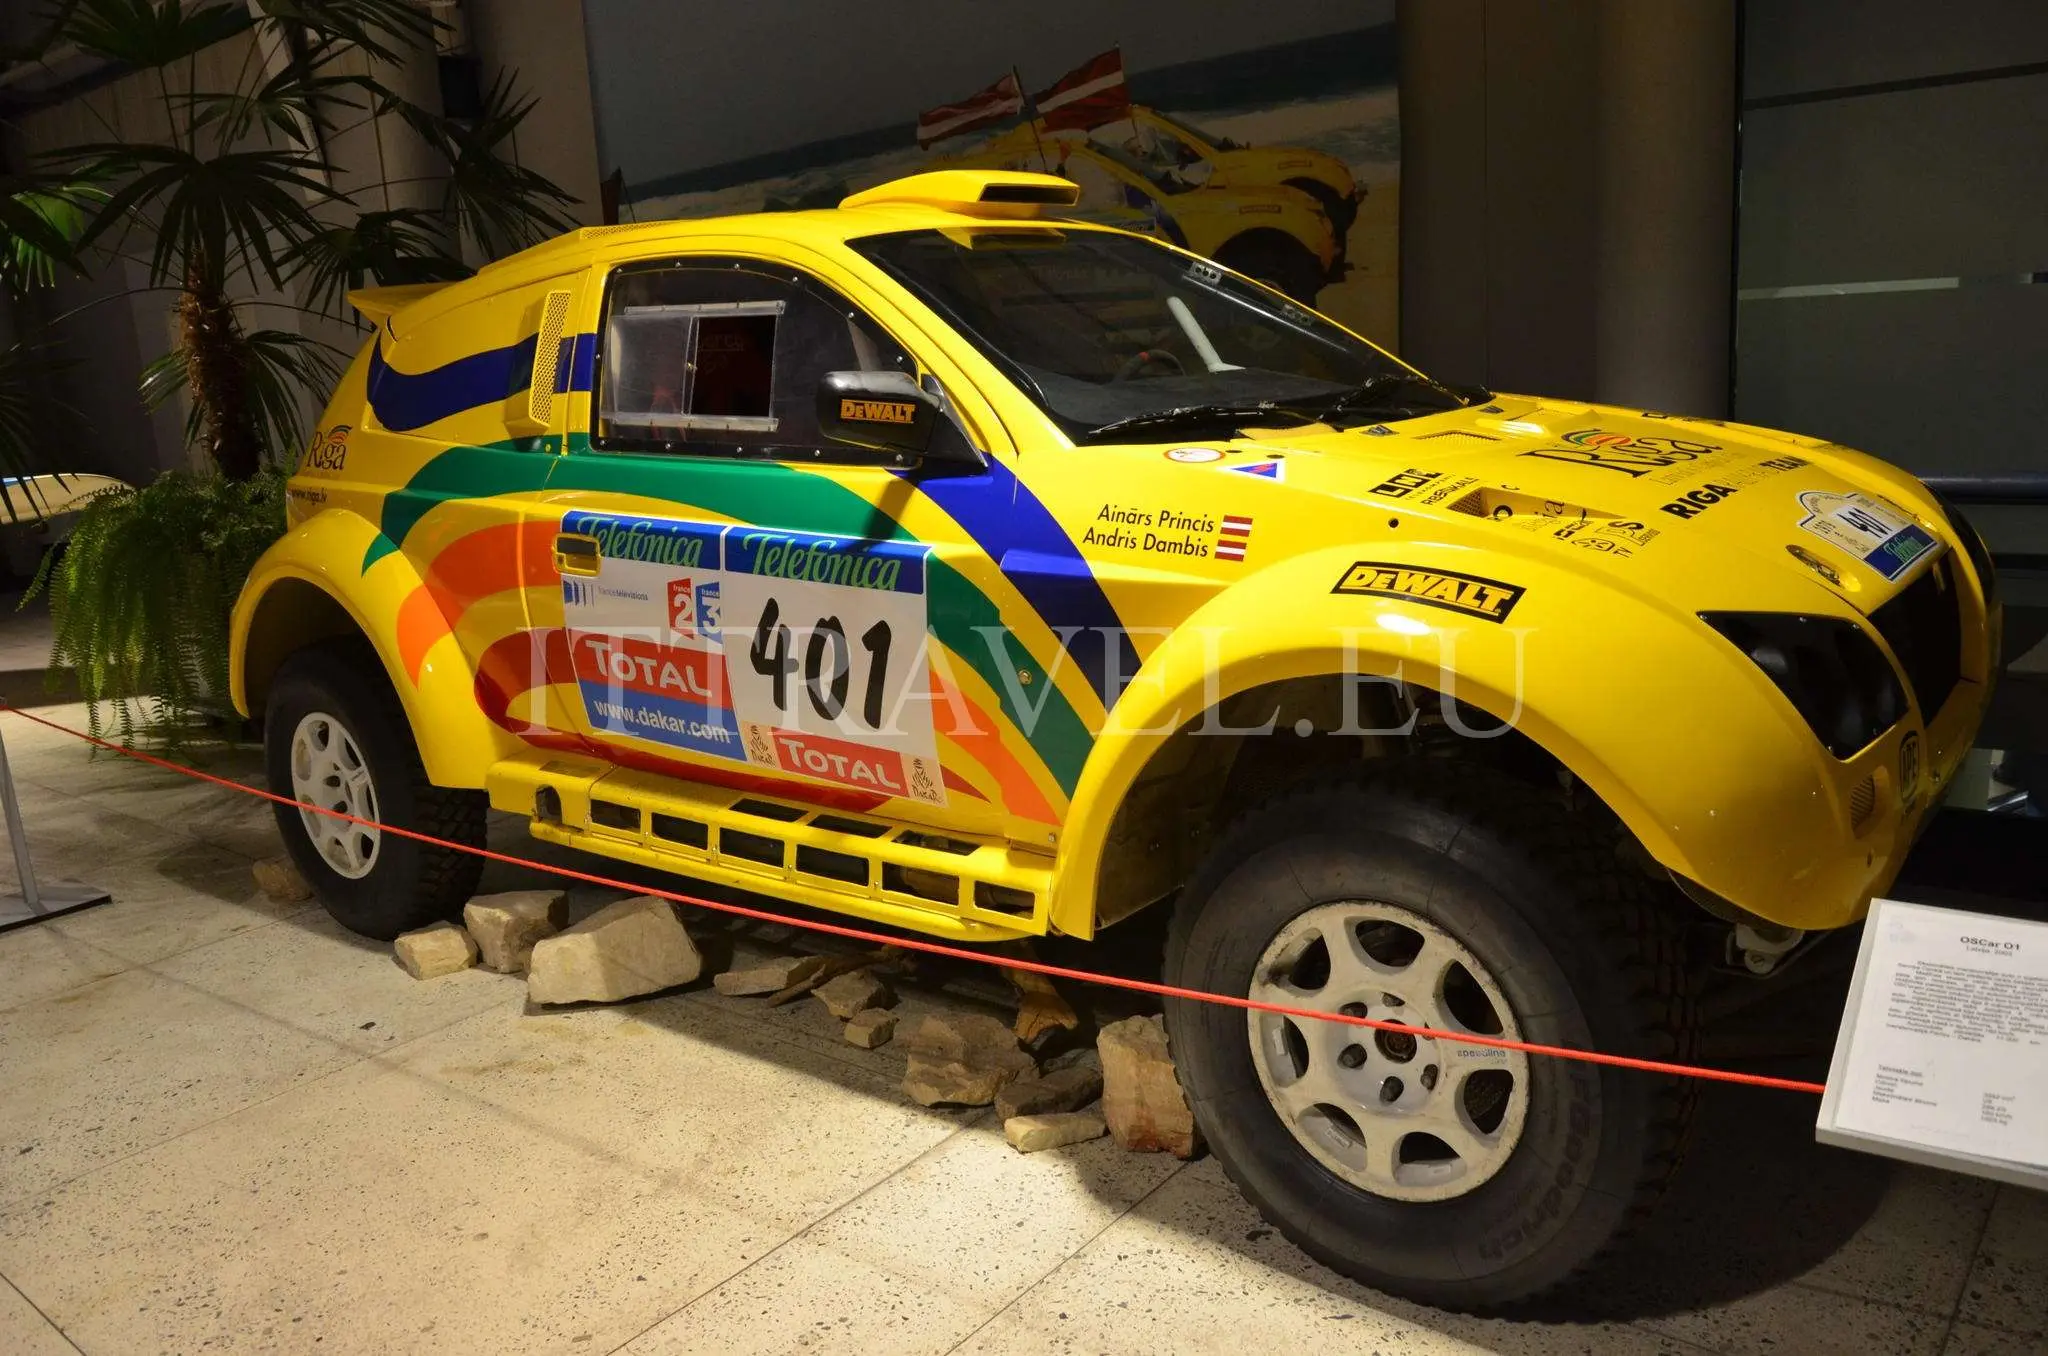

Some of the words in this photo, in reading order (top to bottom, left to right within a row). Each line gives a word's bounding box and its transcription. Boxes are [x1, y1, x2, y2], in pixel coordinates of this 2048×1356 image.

[1097, 503, 1153, 527] Ainārs
[1158, 509, 1215, 533] Princis
[1658, 482, 1738, 520] RIGA
[577, 515, 704, 569] Telefónica
[742, 530, 903, 592] Telefónica
[1083, 526, 1138, 550] Andris
[1143, 532, 1209, 558] Dambis
[674, 594, 693, 628] 2
[1339, 566, 1515, 616] DEWALT
[702, 596, 721, 634] 3
[584, 639, 713, 698] TOTAL
[749, 596, 892, 730] 401
[593, 699, 731, 745] www.dakar.com
[778, 737, 901, 790] TOTAL
[1959, 936, 2001, 949] OSCar
